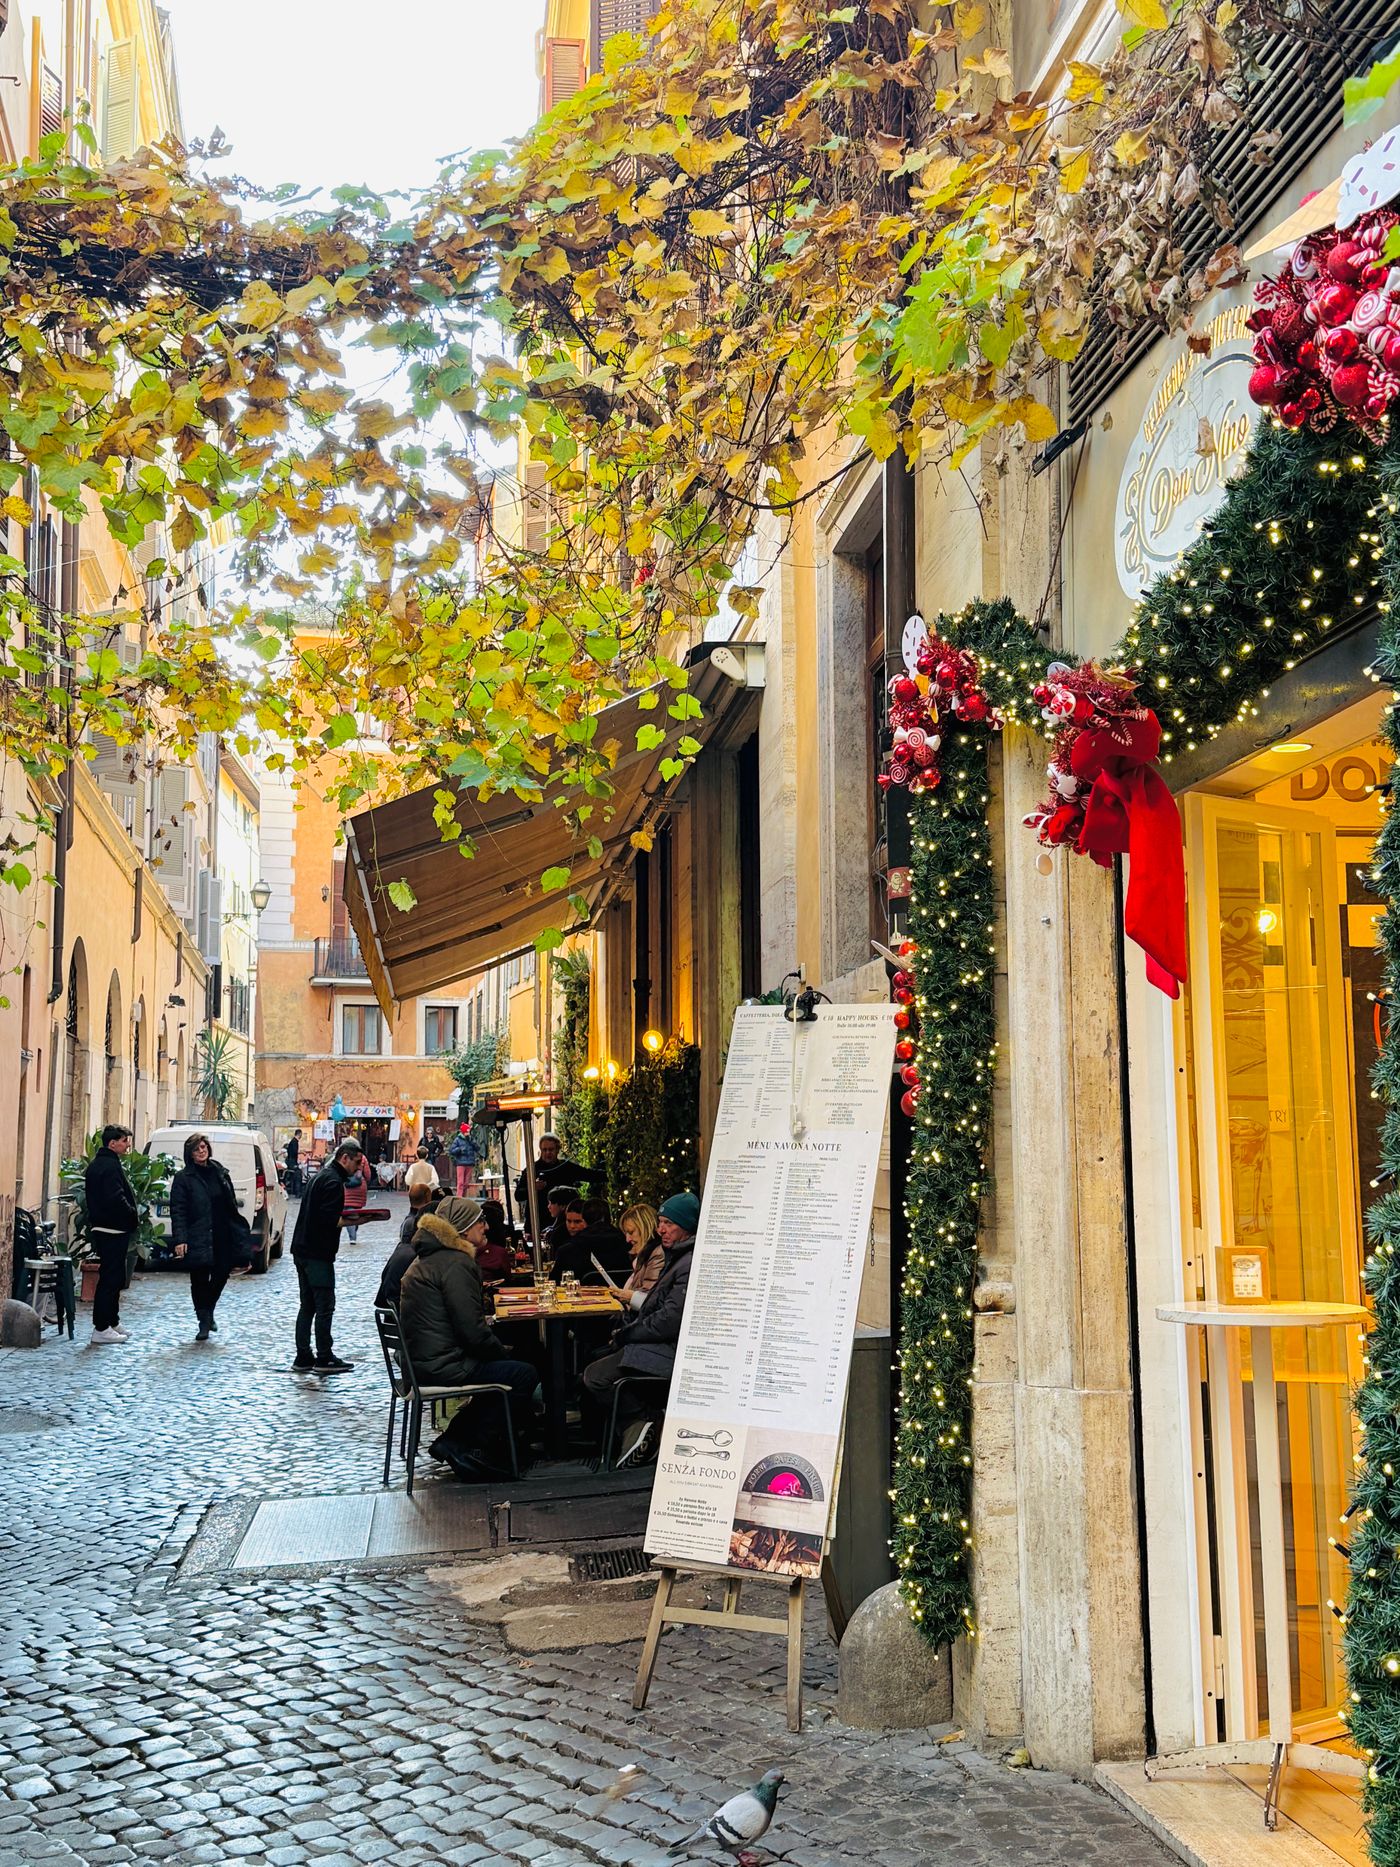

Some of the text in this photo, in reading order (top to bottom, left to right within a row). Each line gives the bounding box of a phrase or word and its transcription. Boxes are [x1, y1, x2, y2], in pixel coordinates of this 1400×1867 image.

[1150, 466, 1192, 540] Don
[774, 1142, 809, 1151] NAVONA
[811, 1142, 842, 1152] NOTTE
[661, 1462, 737, 1481] SENZA FONDO
